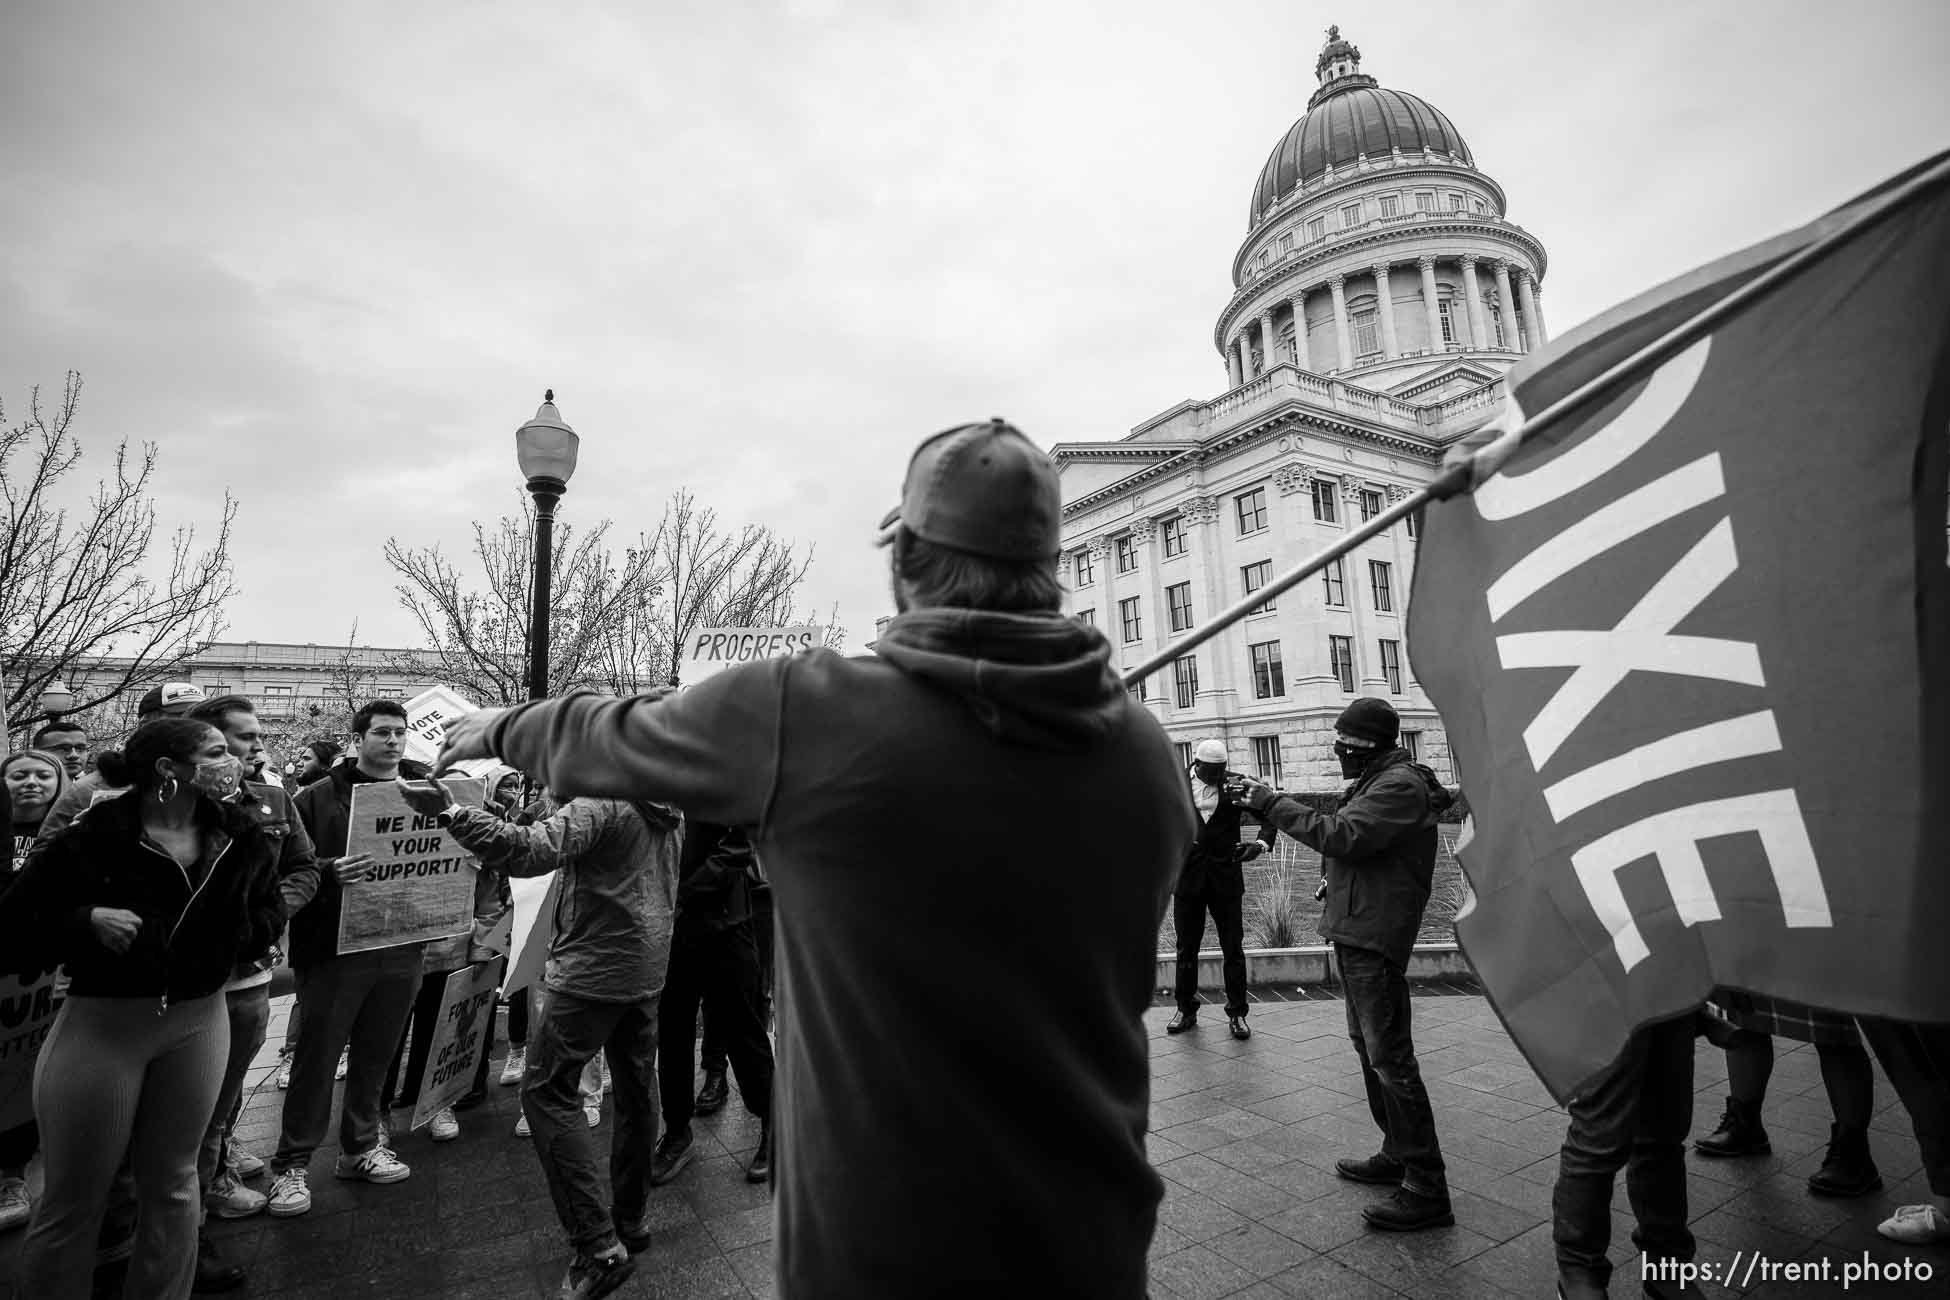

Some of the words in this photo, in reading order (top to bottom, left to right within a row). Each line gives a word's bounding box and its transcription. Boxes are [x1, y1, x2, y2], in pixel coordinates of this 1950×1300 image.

[692, 632, 813, 662] PROGRESS
[408, 710, 443, 732] VOTE
[376, 816, 405, 834] WE
[412, 815, 444, 832] NE
[391, 837, 442, 856] YOUR
[365, 857, 462, 882] SUPPORT!
[437, 1042, 455, 1067] OF
[431, 1049, 476, 1090] FUTURE
